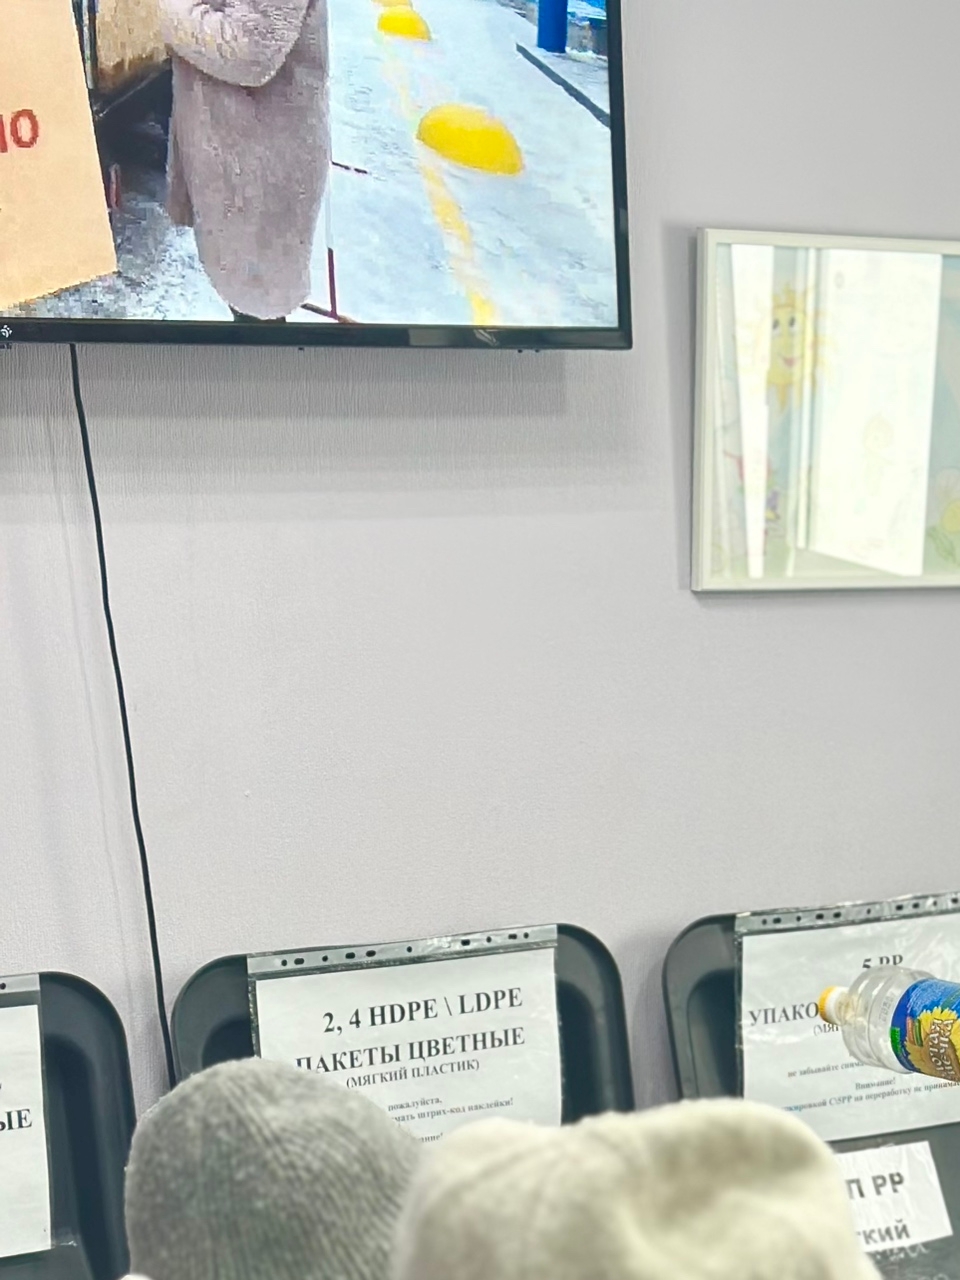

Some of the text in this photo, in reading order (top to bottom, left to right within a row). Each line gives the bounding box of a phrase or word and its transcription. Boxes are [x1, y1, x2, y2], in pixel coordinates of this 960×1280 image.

[323, 1012, 343, 1036] 2,
[349, 1008, 361, 1029] 4
[368, 998, 438, 1027] HDPE
[458, 987, 523, 1015] LDPE
[748, 1001, 820, 1027] УПАКО
[296, 1026, 526, 1074] ПАКЕТЫ ЦВЕТНЫЕ
[346, 1059, 480, 1089] (МЯГКИЙ ПЛАСТИК)
